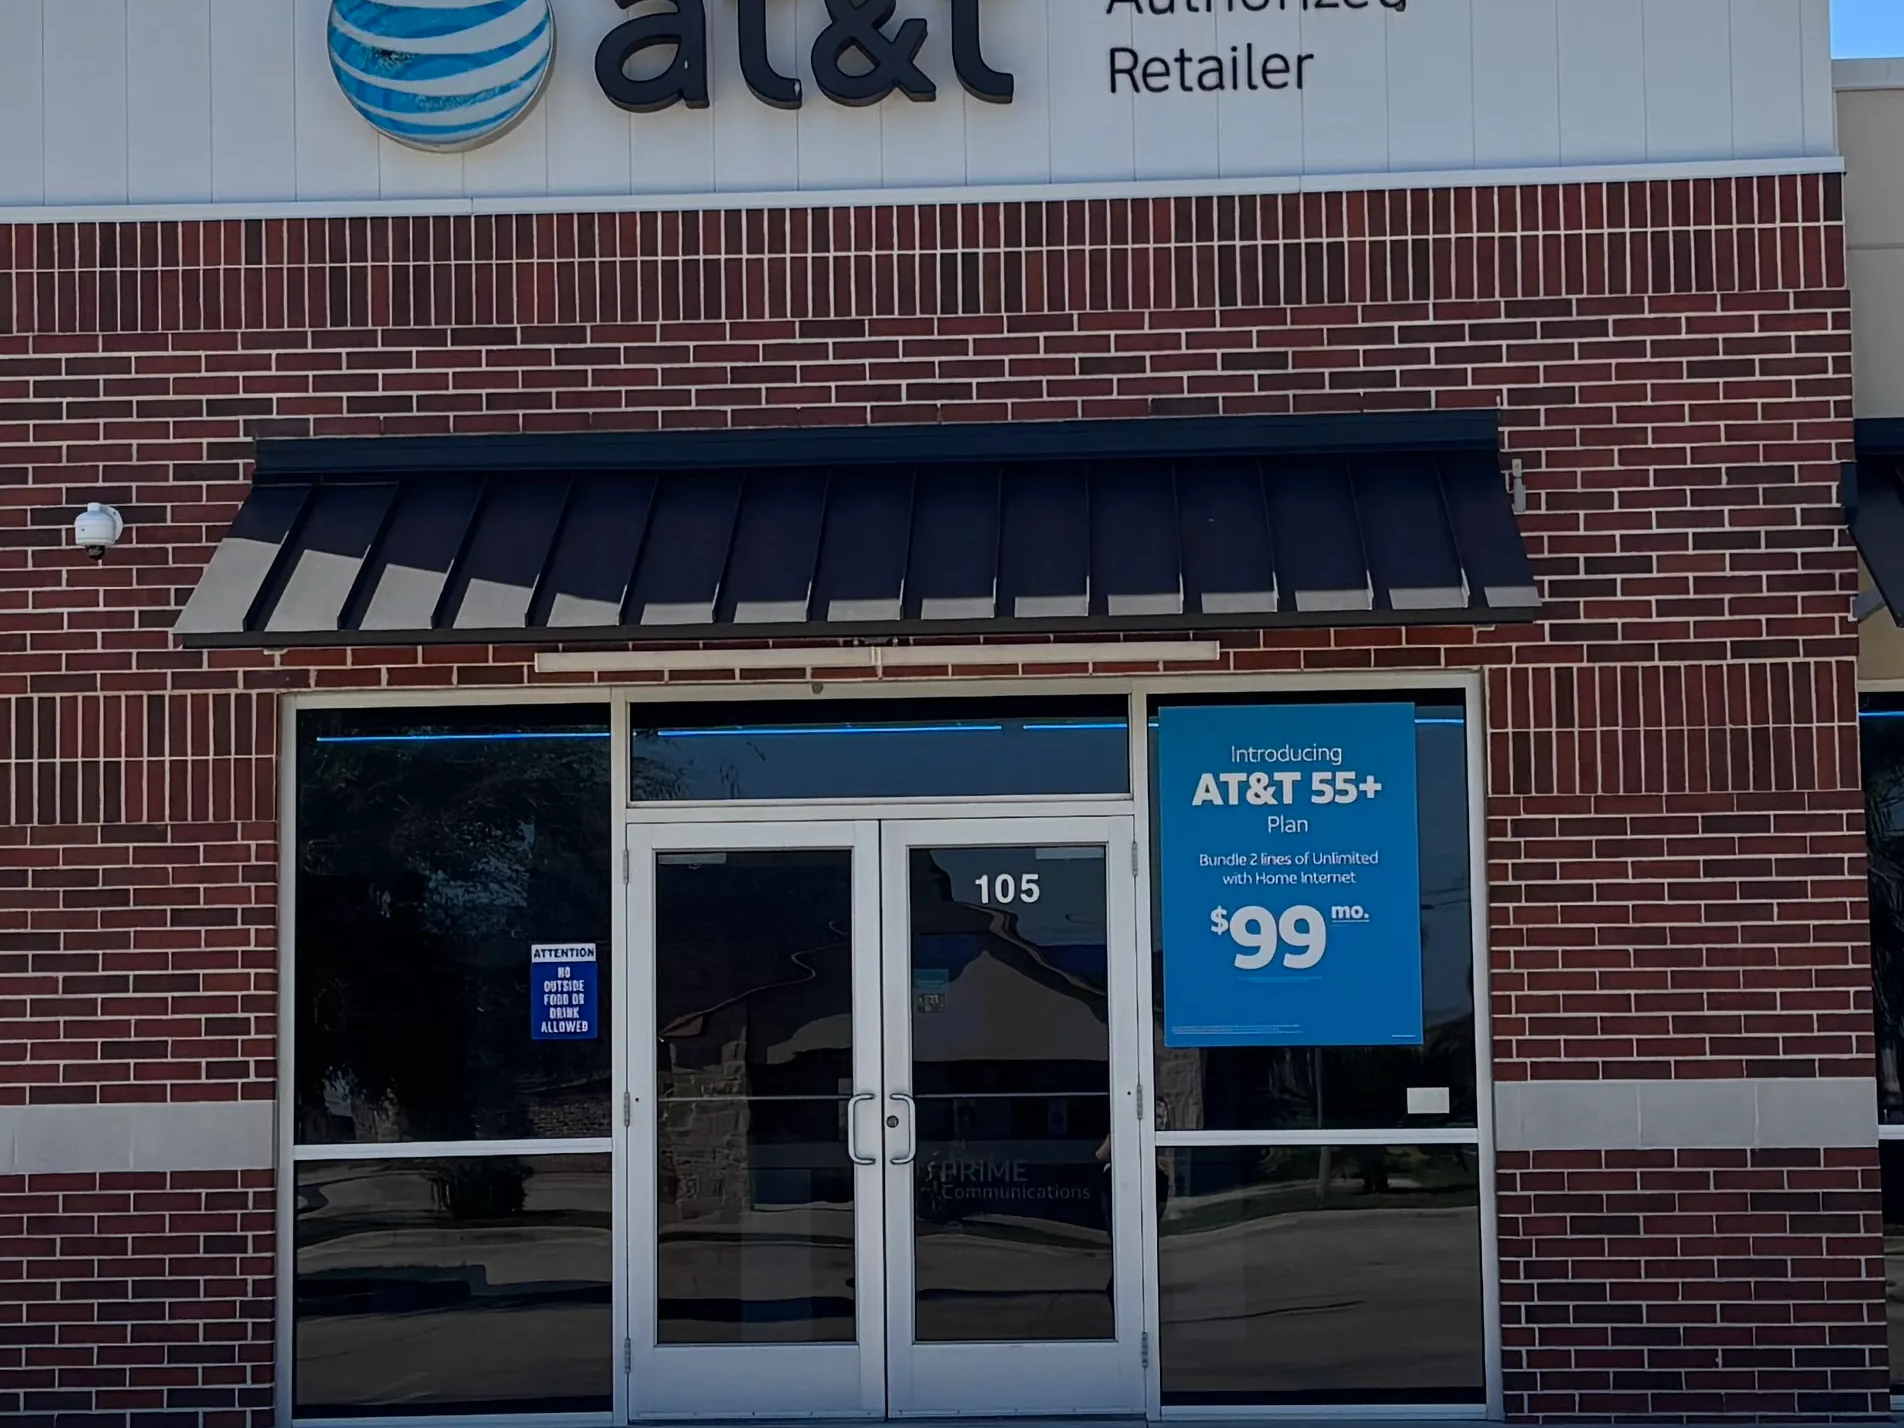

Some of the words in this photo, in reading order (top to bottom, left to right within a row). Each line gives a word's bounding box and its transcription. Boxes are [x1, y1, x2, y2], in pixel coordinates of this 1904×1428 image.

[1109, 42, 1315, 93] Retailer
[1232, 743, 1343, 766] Introducing
[1192, 772, 1302, 806] AT&T
[1311, 771, 1382, 804] 55+
[1267, 814, 1309, 833] Plan
[1199, 853, 1247, 866] Bundle
[1250, 853, 1258, 865] 2
[1261, 852, 1292, 866] lines
[1295, 851, 1310, 865] of
[1312, 850, 1379, 865] Unlimited
[1222, 871, 1252, 885] with
[1256, 871, 1297, 884] Home
[1301, 871, 1357, 884] Internet
[975, 874, 1040, 904] 105
[1331, 905, 1370, 922] mo.
[533, 947, 595, 959] ATTENTION
[557, 966, 571, 978] NO
[543, 980, 585, 992] OUTSIDE
[543, 993, 569, 1006] FOOD
[549, 1007, 580, 1019] DRINK
[540, 1020, 589, 1033] ALLOWED
[940, 1159, 1029, 1183] PRIME
[942, 1183, 1092, 1201] Communications
